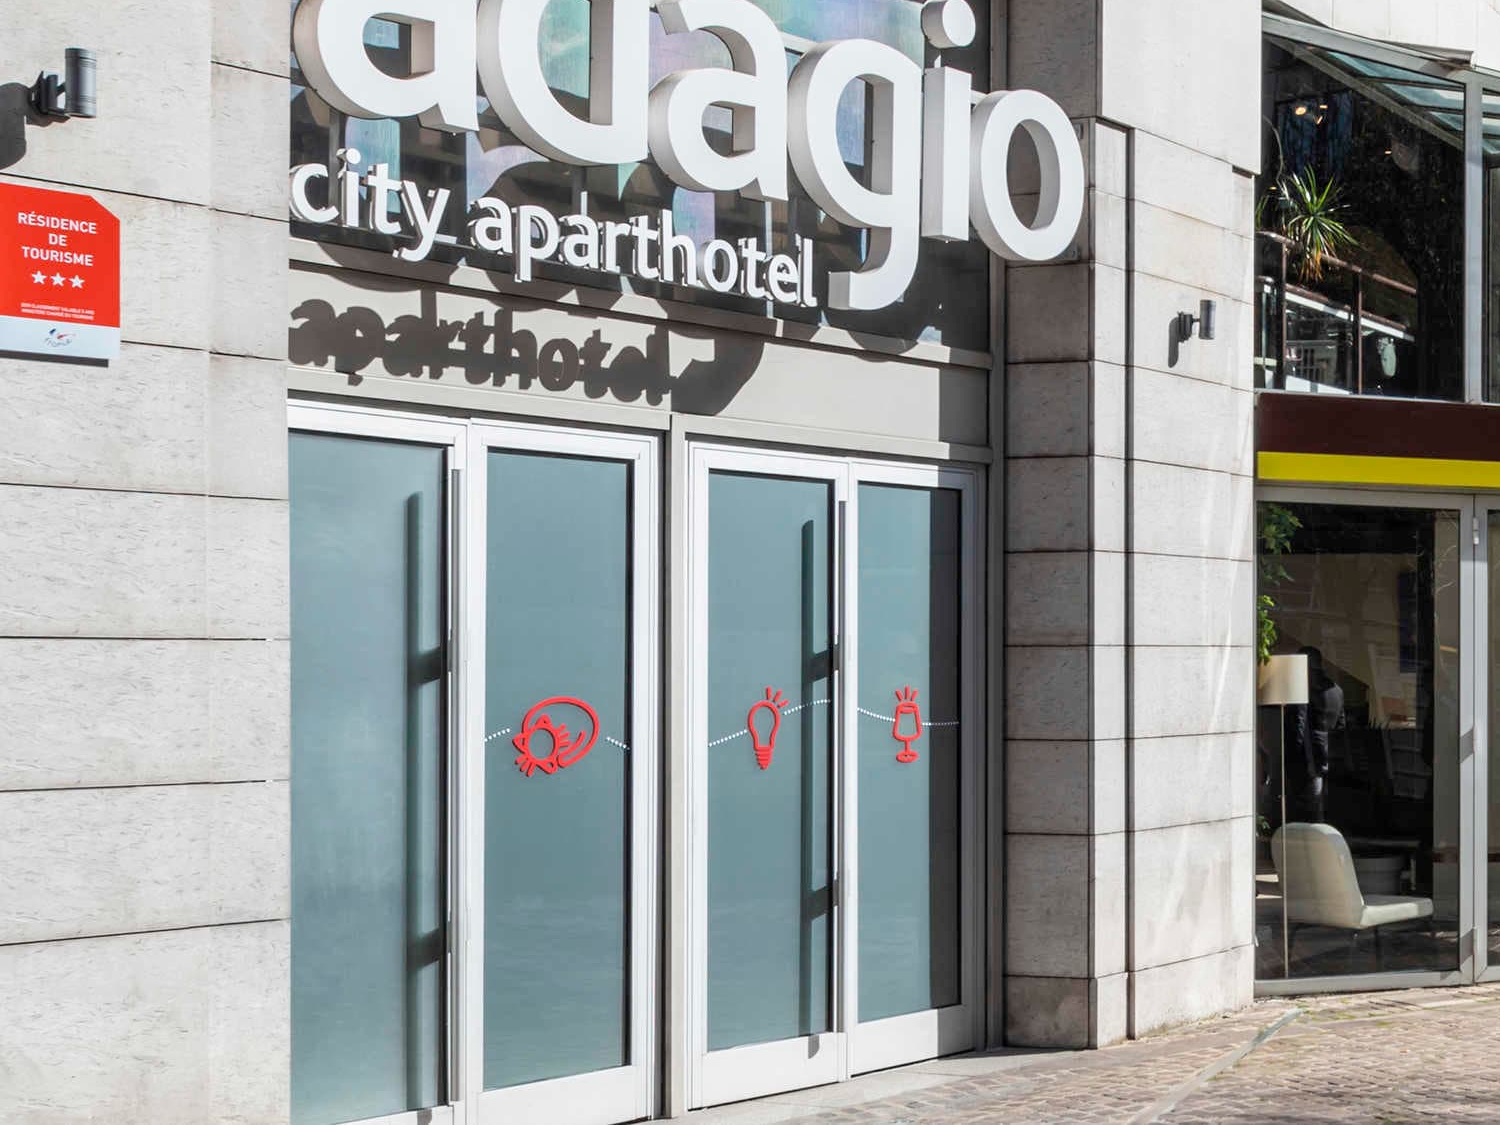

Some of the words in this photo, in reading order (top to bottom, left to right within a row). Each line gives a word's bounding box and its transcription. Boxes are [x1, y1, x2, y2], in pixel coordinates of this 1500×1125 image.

[18, 212, 97, 234] RÉSIDENCE
[290, 148, 450, 262] city
[470, 196, 818, 308] aparthotel
[48, 233, 67, 247] DE
[22, 246, 94, 266] TOURISME
